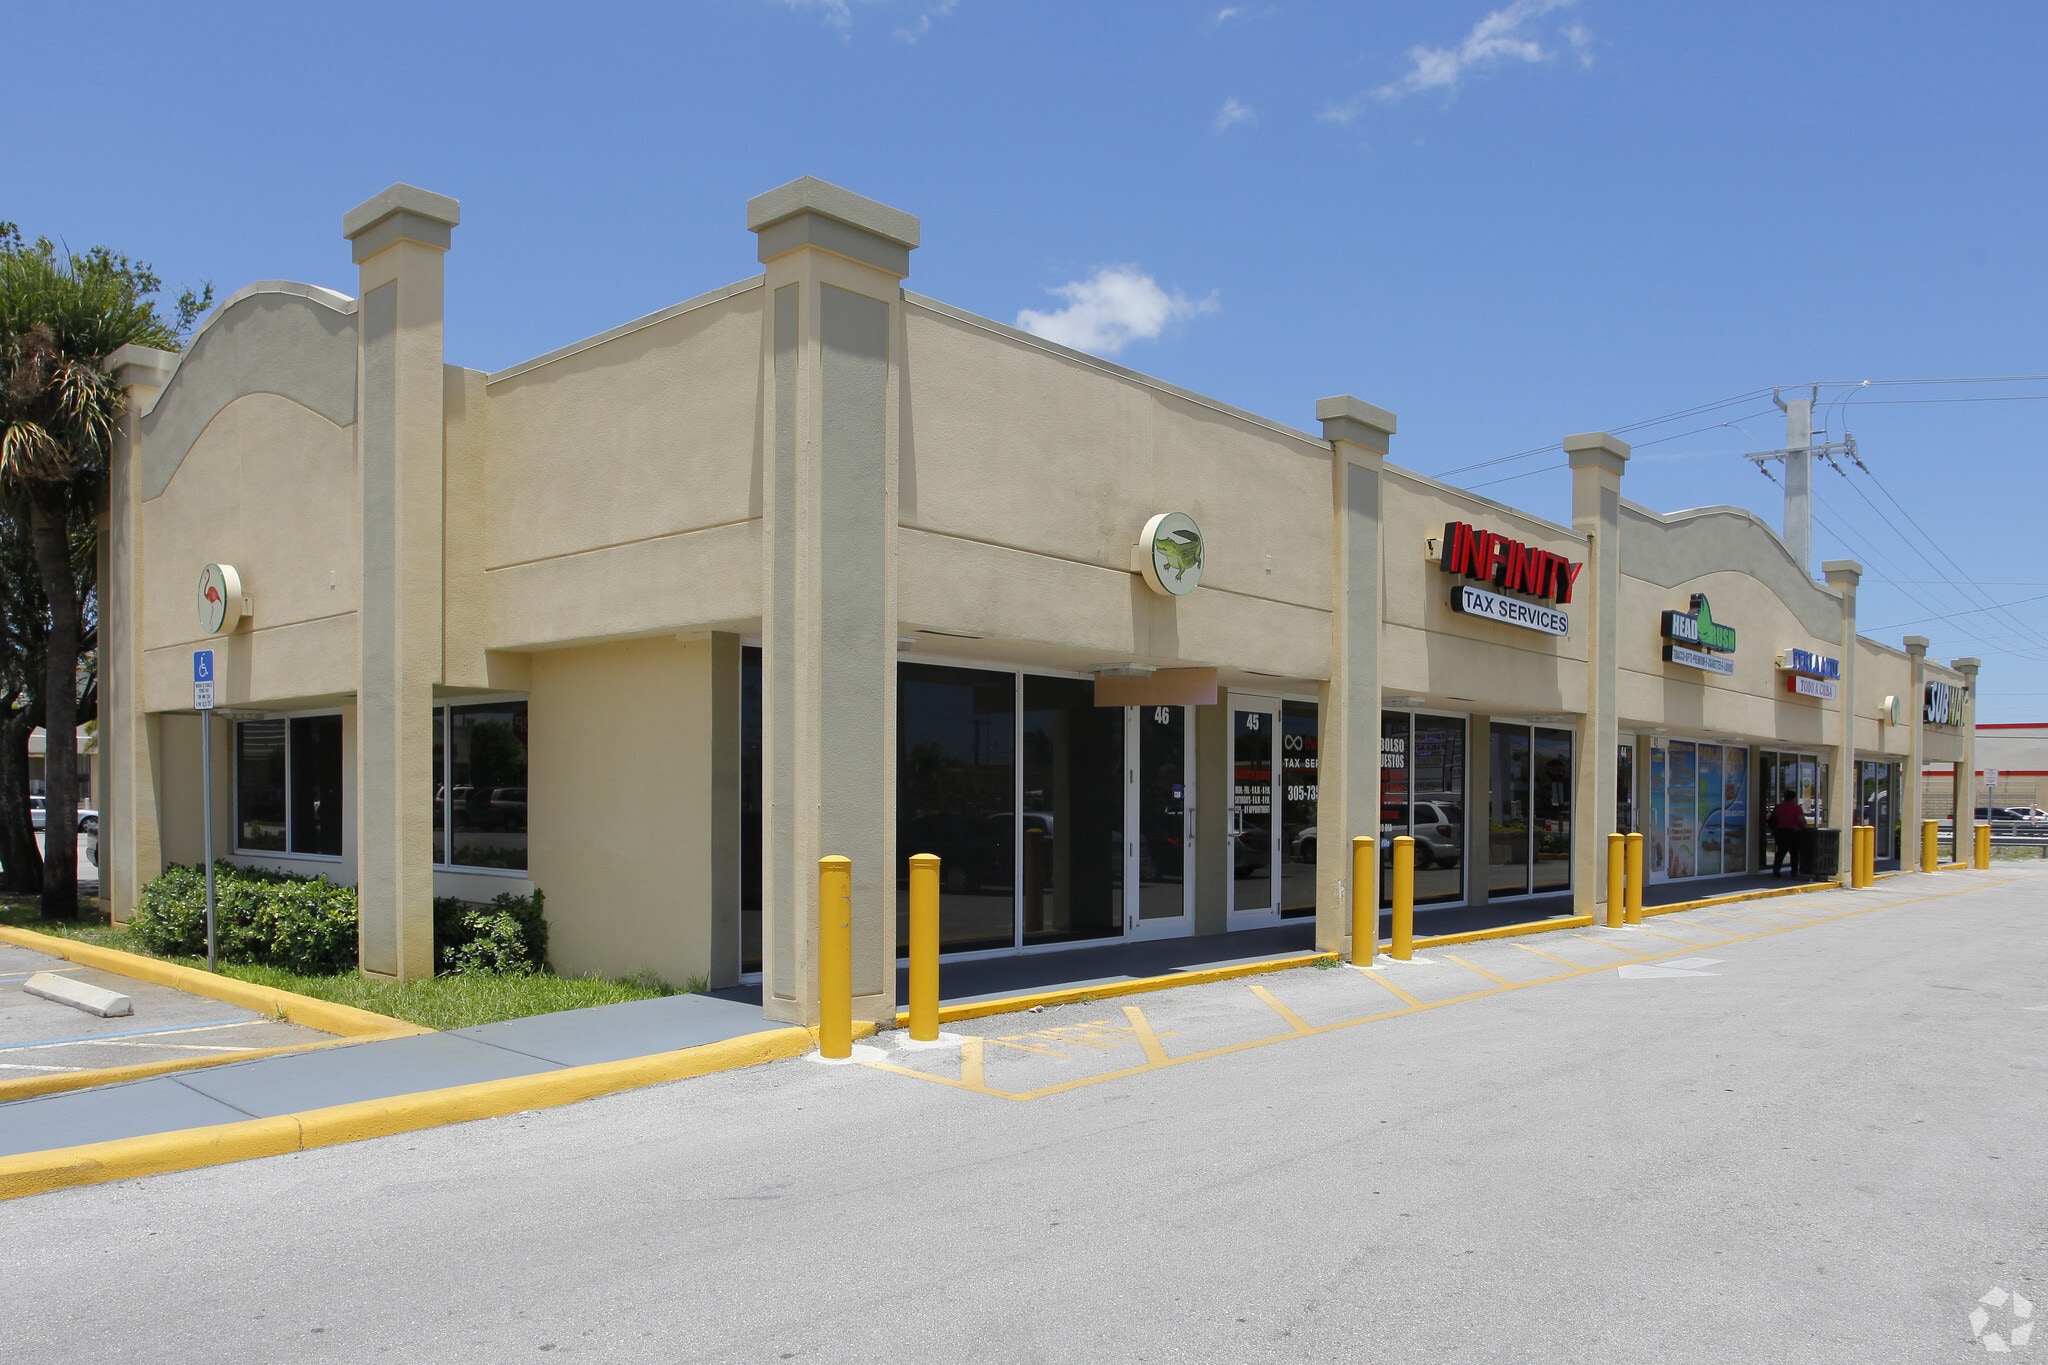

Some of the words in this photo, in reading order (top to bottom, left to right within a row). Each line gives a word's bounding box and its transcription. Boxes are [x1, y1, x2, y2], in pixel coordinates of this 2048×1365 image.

[1449, 521, 1583, 604] INFINITY
[1464, 590, 1494, 614] TAX
[1498, 600, 1567, 633] SERVICES
[1672, 613, 1698, 641] HEAD
[1711, 625, 1735, 651] RUSH
[1155, 707, 1169, 725] 46
[1246, 714, 1259, 730] 45
[1284, 758, 1300, 768] TAX
